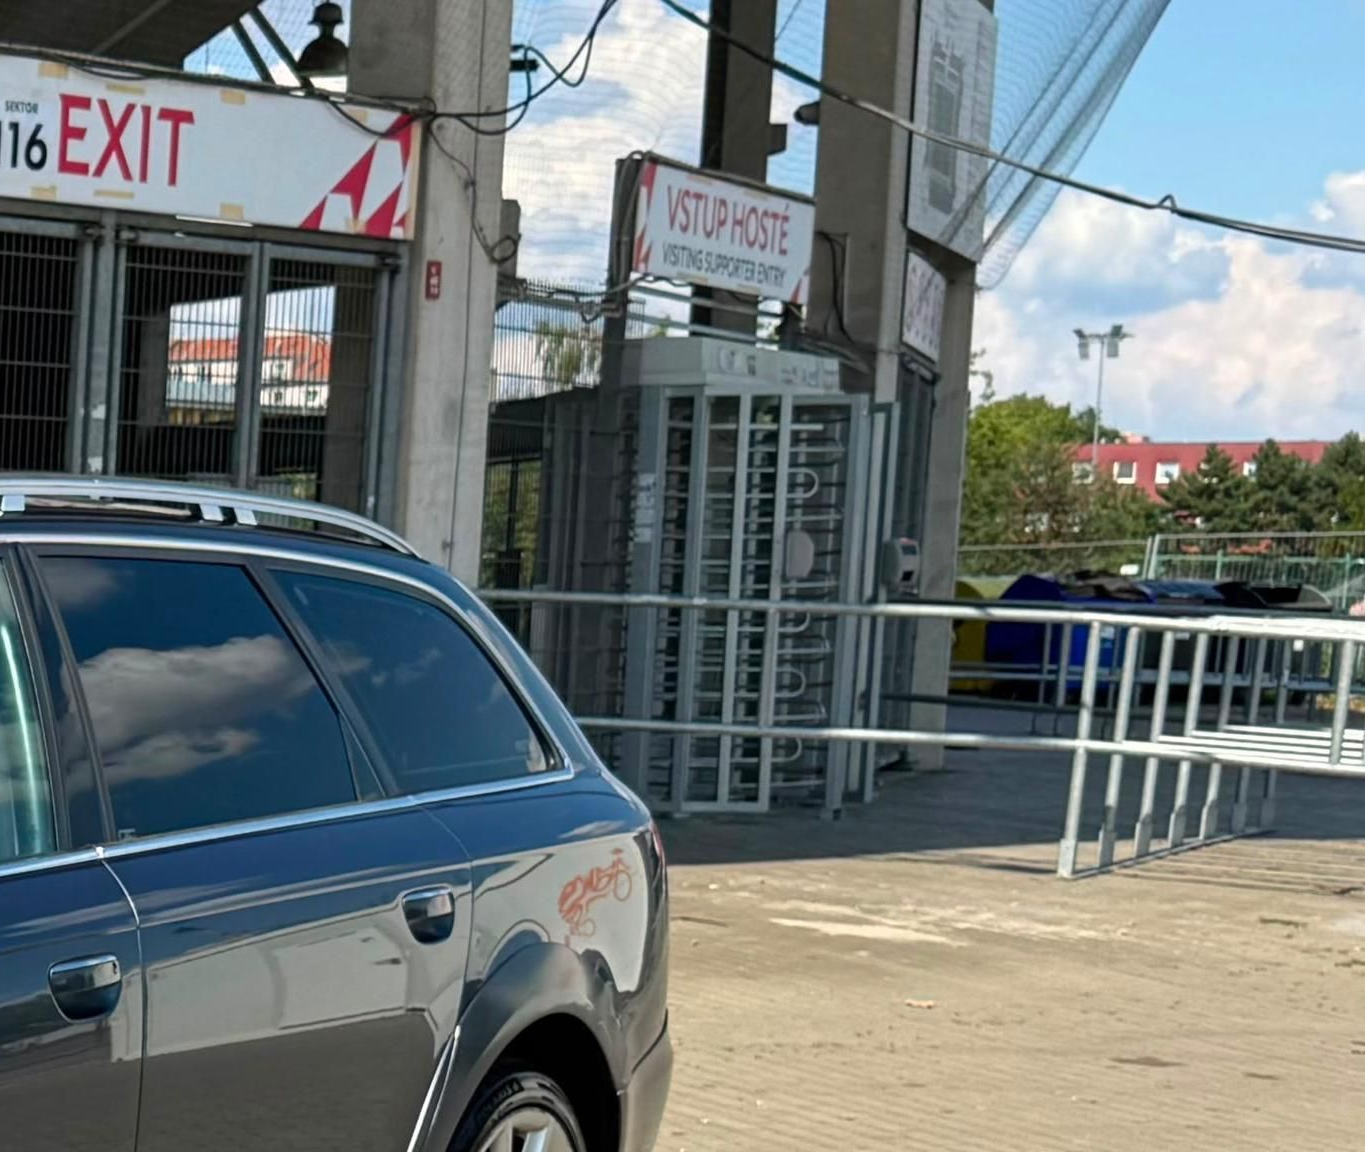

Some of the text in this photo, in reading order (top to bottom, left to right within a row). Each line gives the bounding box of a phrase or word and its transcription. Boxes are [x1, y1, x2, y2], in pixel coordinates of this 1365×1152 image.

[4, 99, 39, 114] SEKTOR
[57, 93, 196, 185] EXIT
[667, 184, 791, 256] VSTUP HOSTÉ
[661, 241, 788, 289] VISITING SUPPORTER ENTRY
